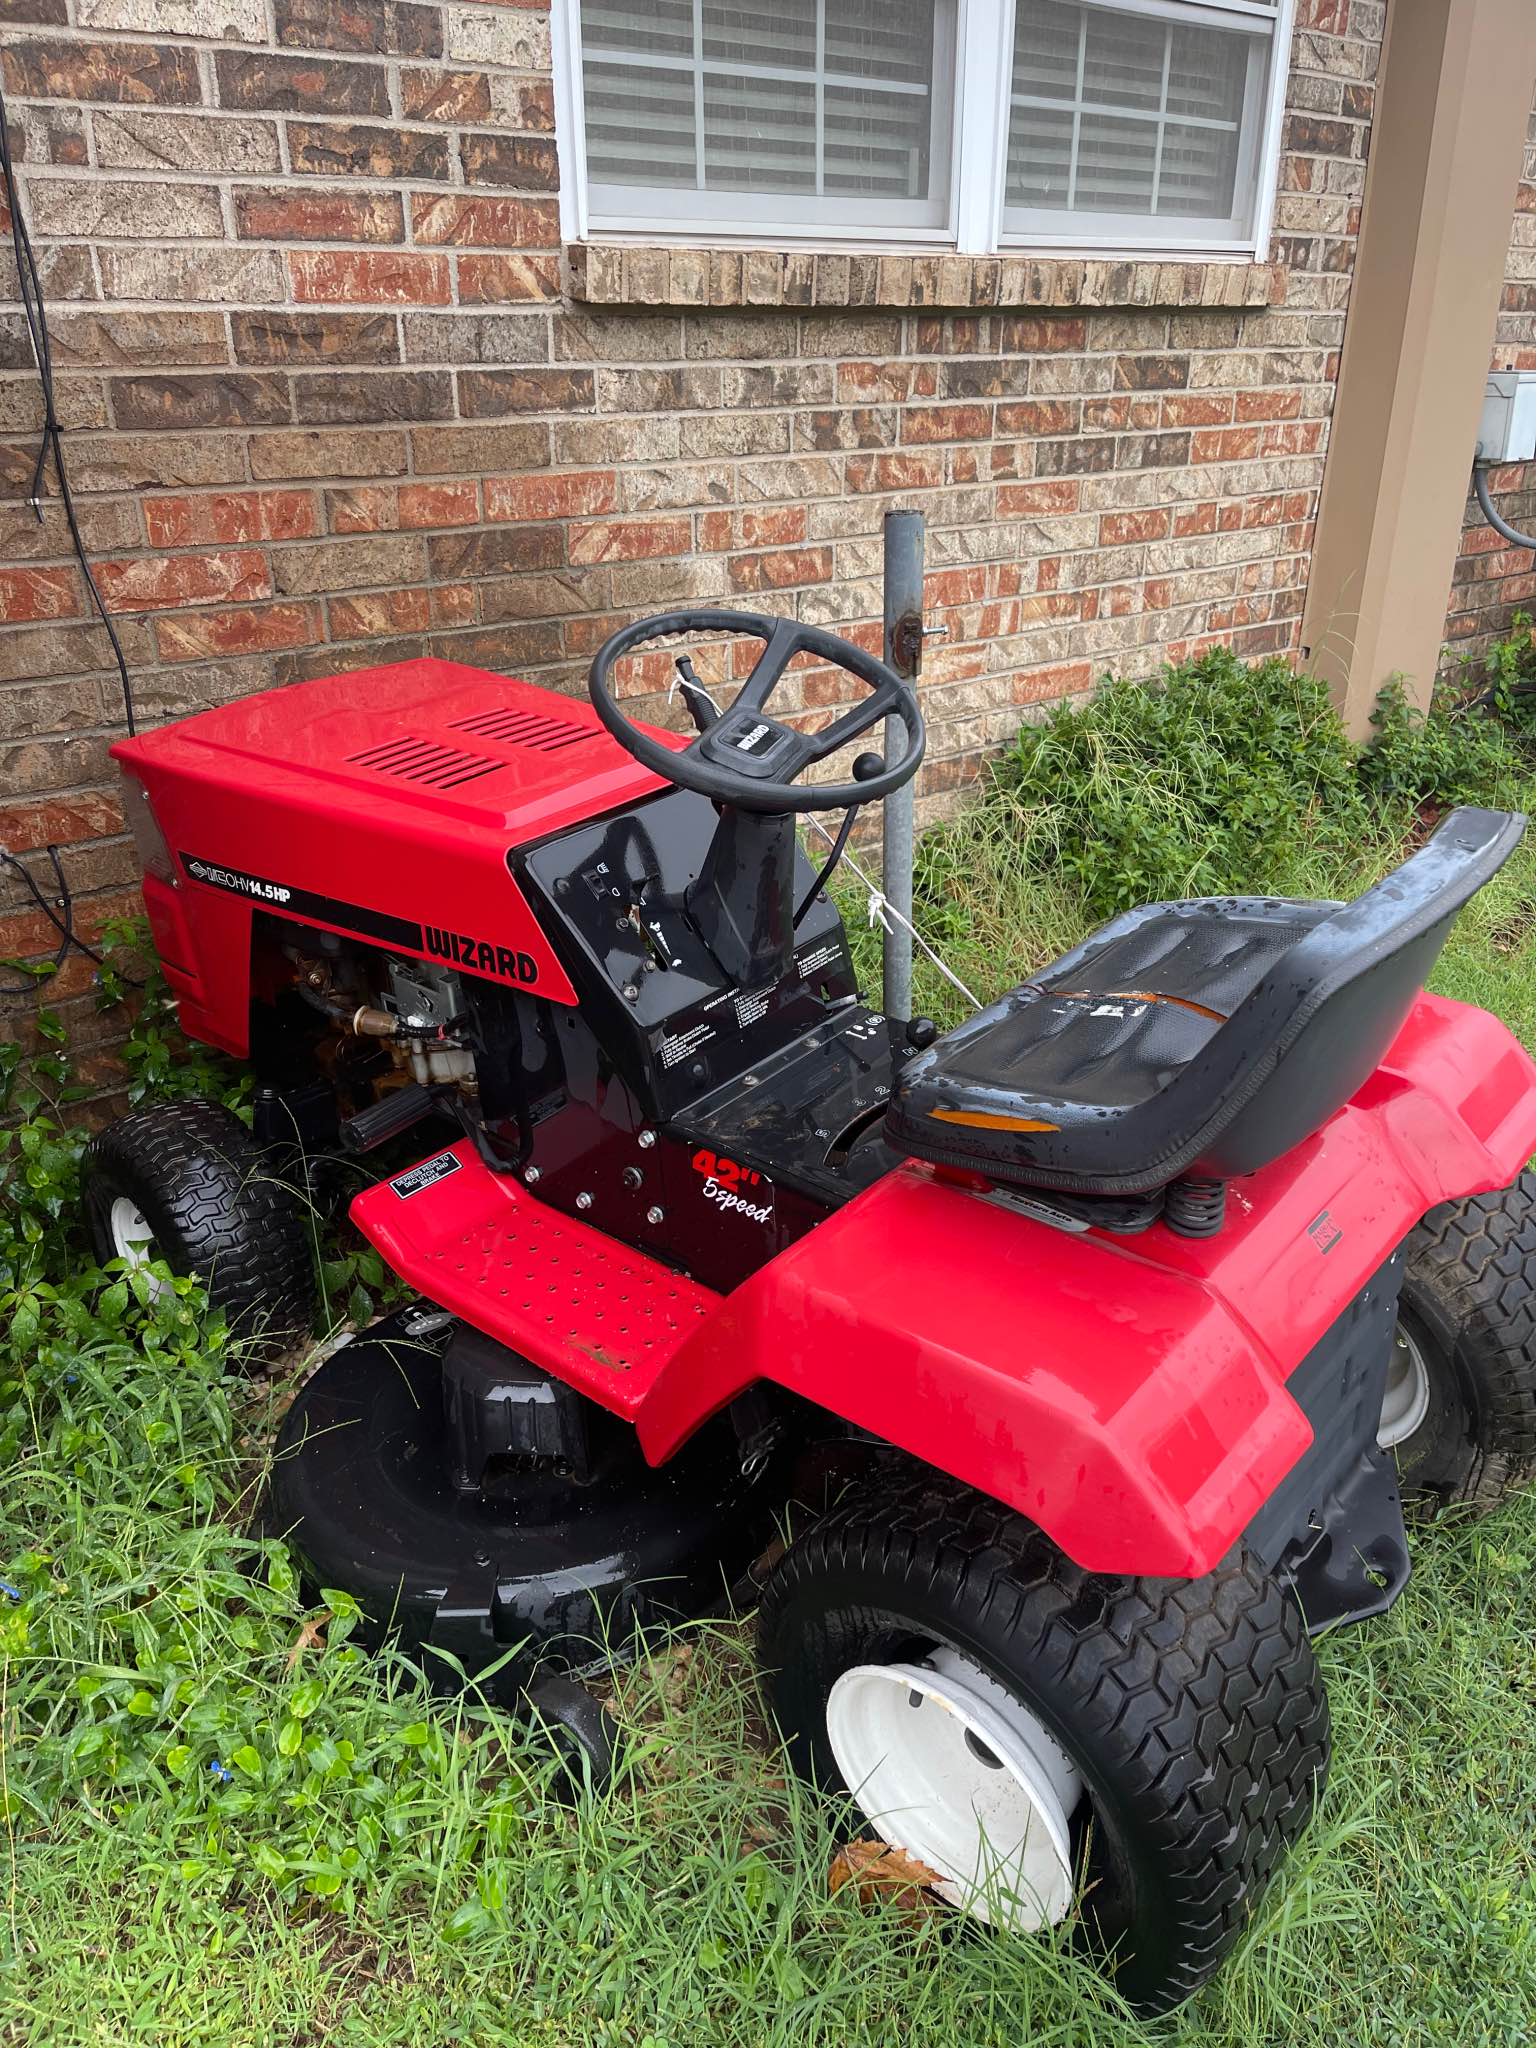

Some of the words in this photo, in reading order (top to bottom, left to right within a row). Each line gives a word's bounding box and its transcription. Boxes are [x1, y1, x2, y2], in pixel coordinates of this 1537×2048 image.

[737, 725, 769, 750] WIZARD
[424, 926, 539, 984] WIZARD
[396, 1169, 422, 1186] DEPRESS
[422, 1161, 441, 1172] PEDAL
[404, 1169, 436, 1188] DECLUTCH
[436, 1162, 449, 1171] AND
[420, 1172, 441, 1186] BRAKE
[692, 1149, 761, 1193] 42"
[1049, 1211, 1073, 1223] Auto
